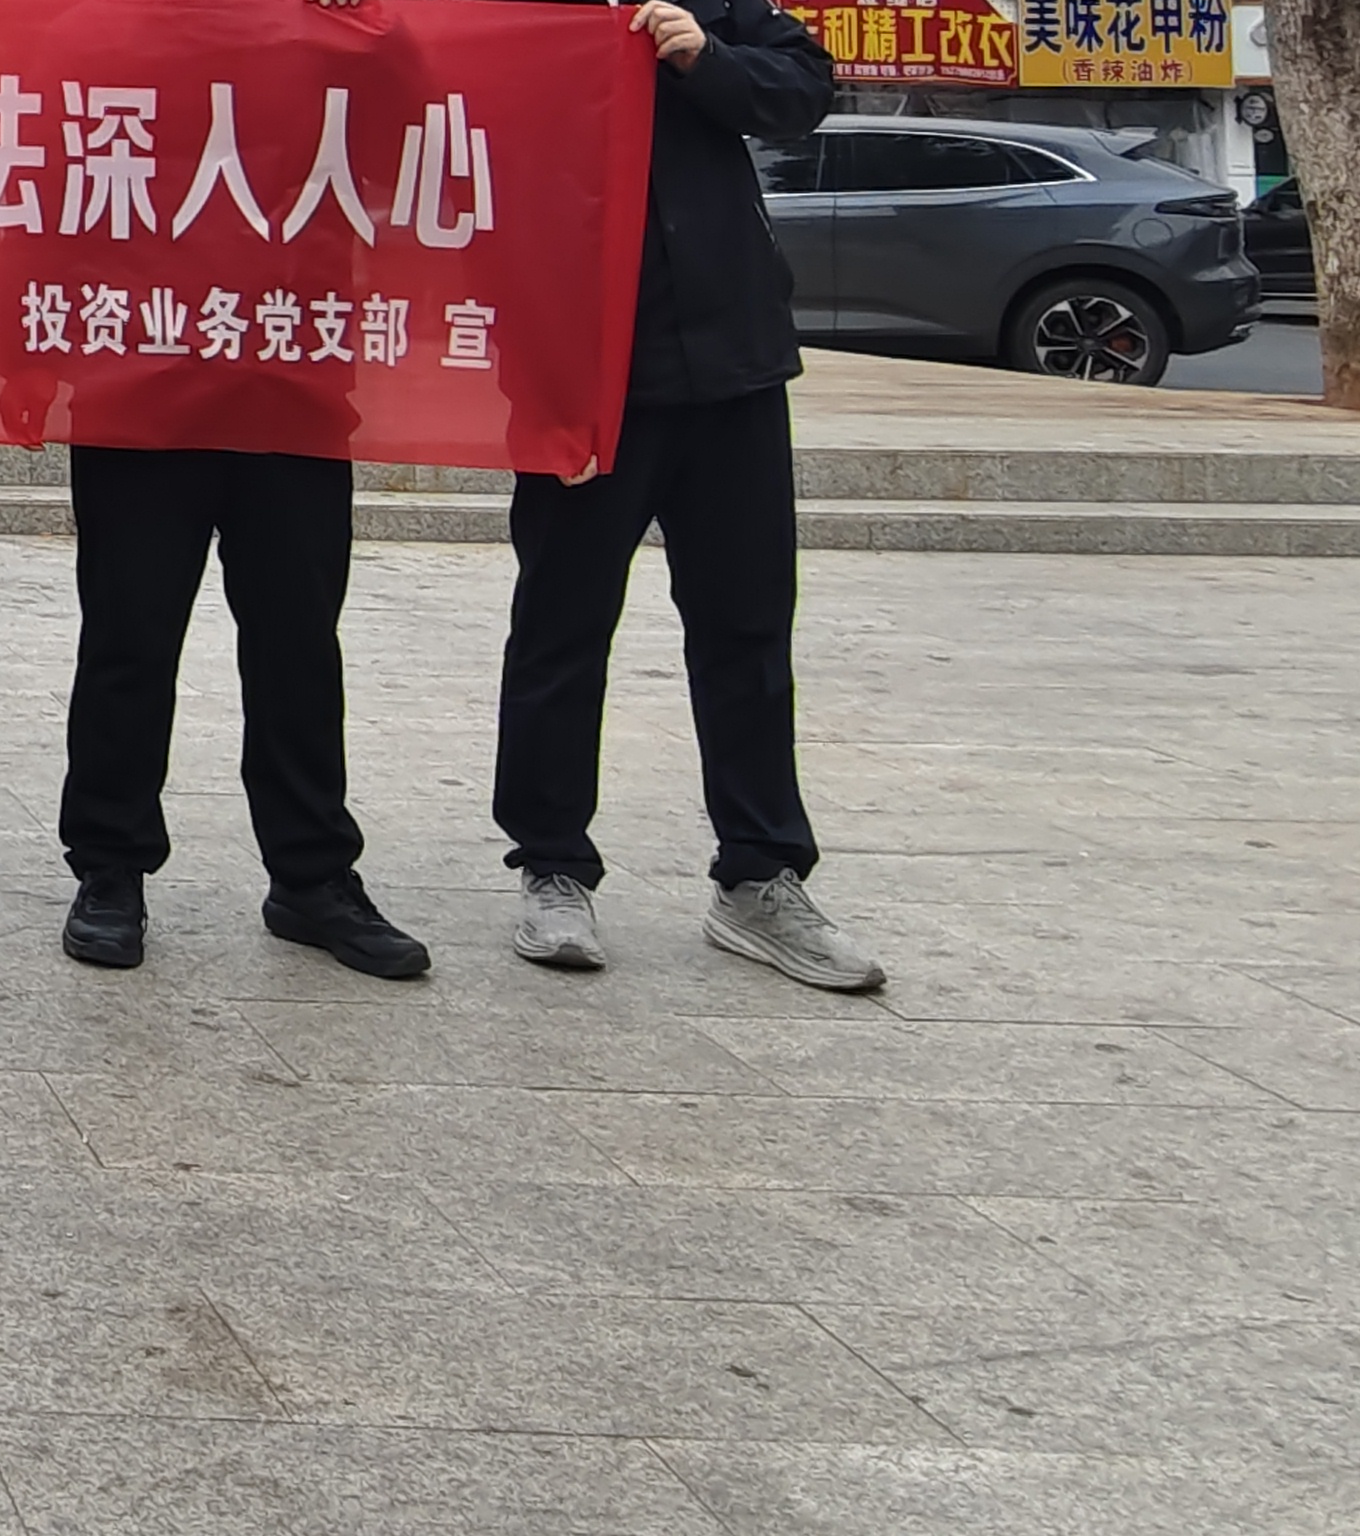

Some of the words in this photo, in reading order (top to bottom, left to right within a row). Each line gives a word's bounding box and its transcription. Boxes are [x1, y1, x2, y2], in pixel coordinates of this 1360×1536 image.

[20, 280, 410, 368] 投资业务党支部
[440, 298, 496, 370] 宣
